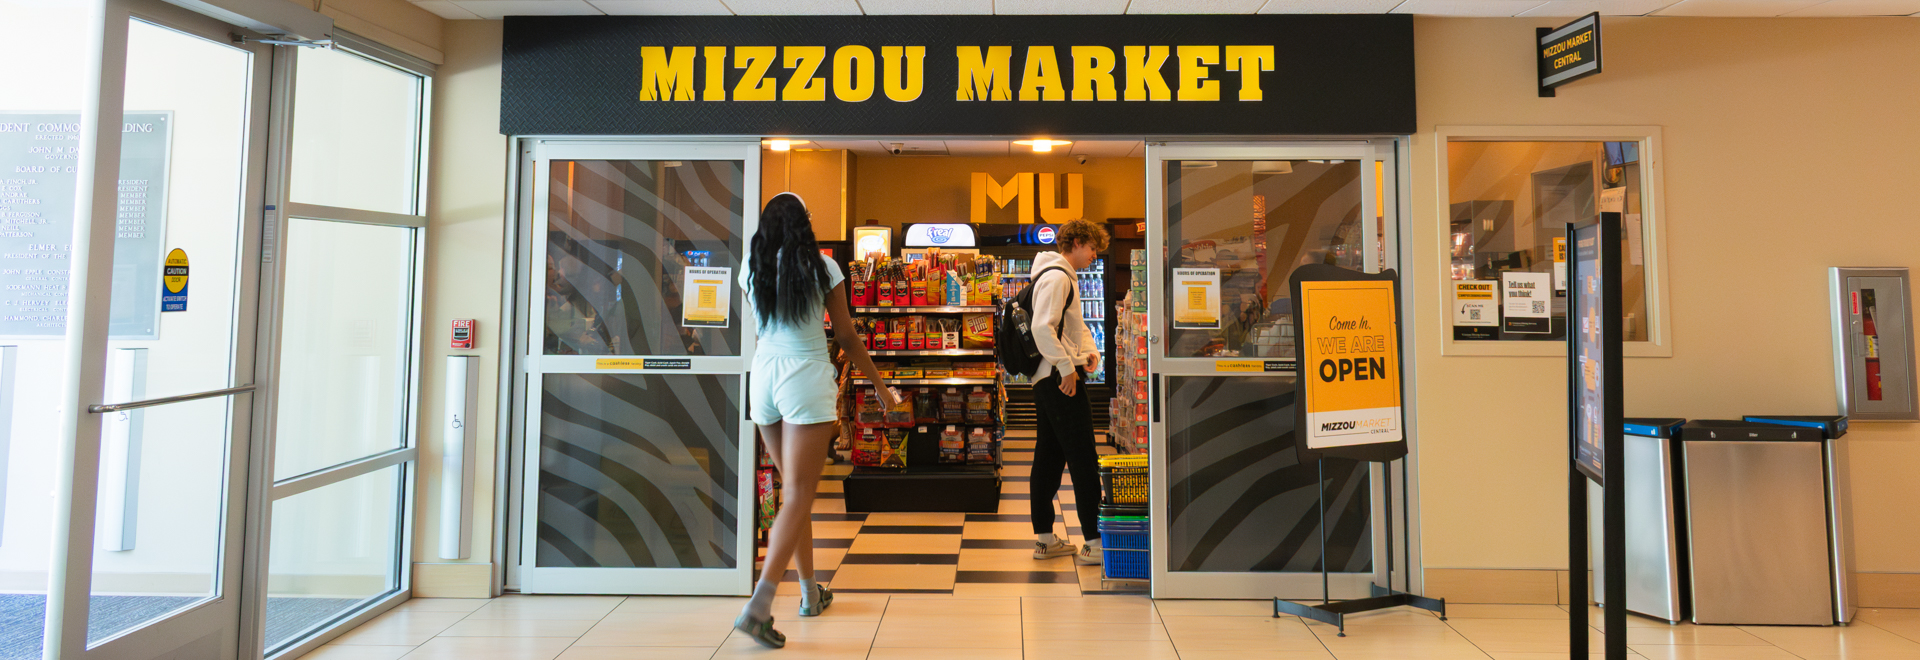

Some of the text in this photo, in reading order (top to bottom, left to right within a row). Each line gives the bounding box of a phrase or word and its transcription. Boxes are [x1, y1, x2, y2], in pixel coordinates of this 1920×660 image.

[1544, 30, 1592, 58] MIZZOU MARKET
[1554, 51, 1582, 69] CENTRAL
[640, 45, 1275, 102] MIZZOU MARKET
[122, 123, 153, 132] DING
[971, 172, 1084, 224] MU
[1329, 315, 1371, 330] Come In.
[1317, 335, 1385, 354] WE ARE
[1319, 357, 1385, 382] OPEN
